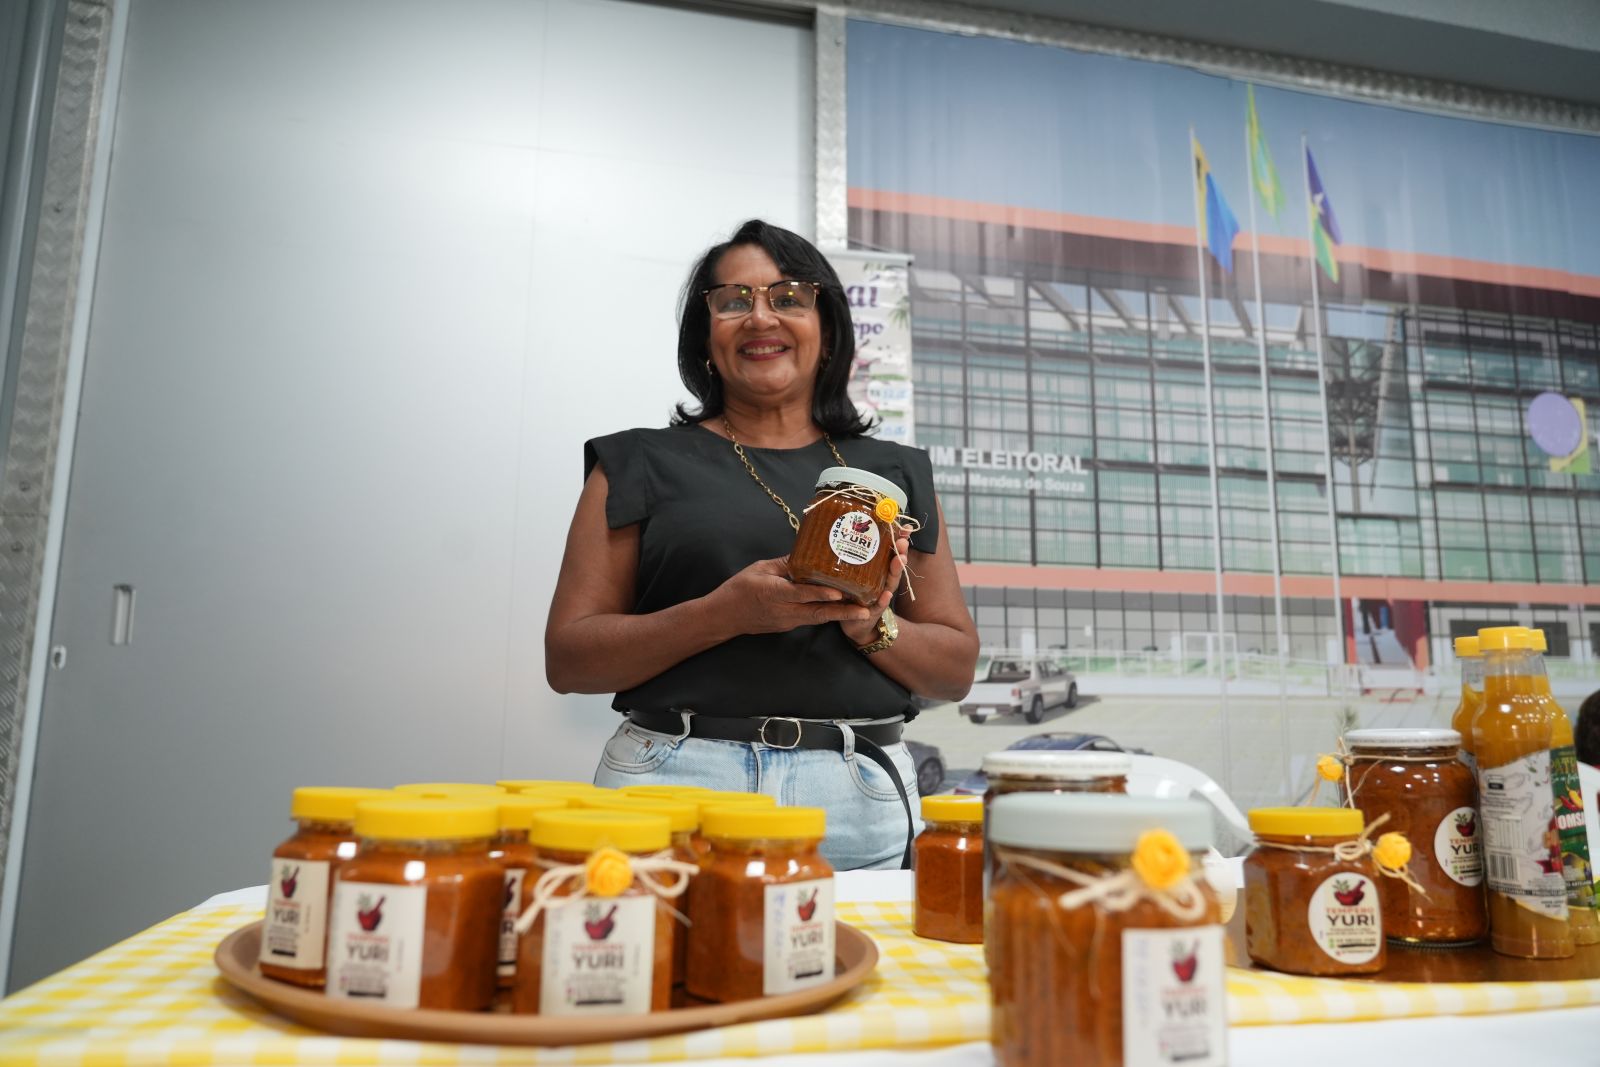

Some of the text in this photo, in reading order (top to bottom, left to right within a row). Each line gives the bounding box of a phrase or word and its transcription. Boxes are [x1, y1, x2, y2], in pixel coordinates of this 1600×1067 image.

[961, 448, 1089, 475] ELEITORAL
[1024, 478, 1042, 490] de
[1044, 478, 1085, 492] Souza
[841, 531, 872, 549] YURI
[1326, 914, 1375, 927] YURI
[790, 930, 824, 949] YURI
[347, 943, 390, 962] YURI
[571, 952, 625, 970] YURI
